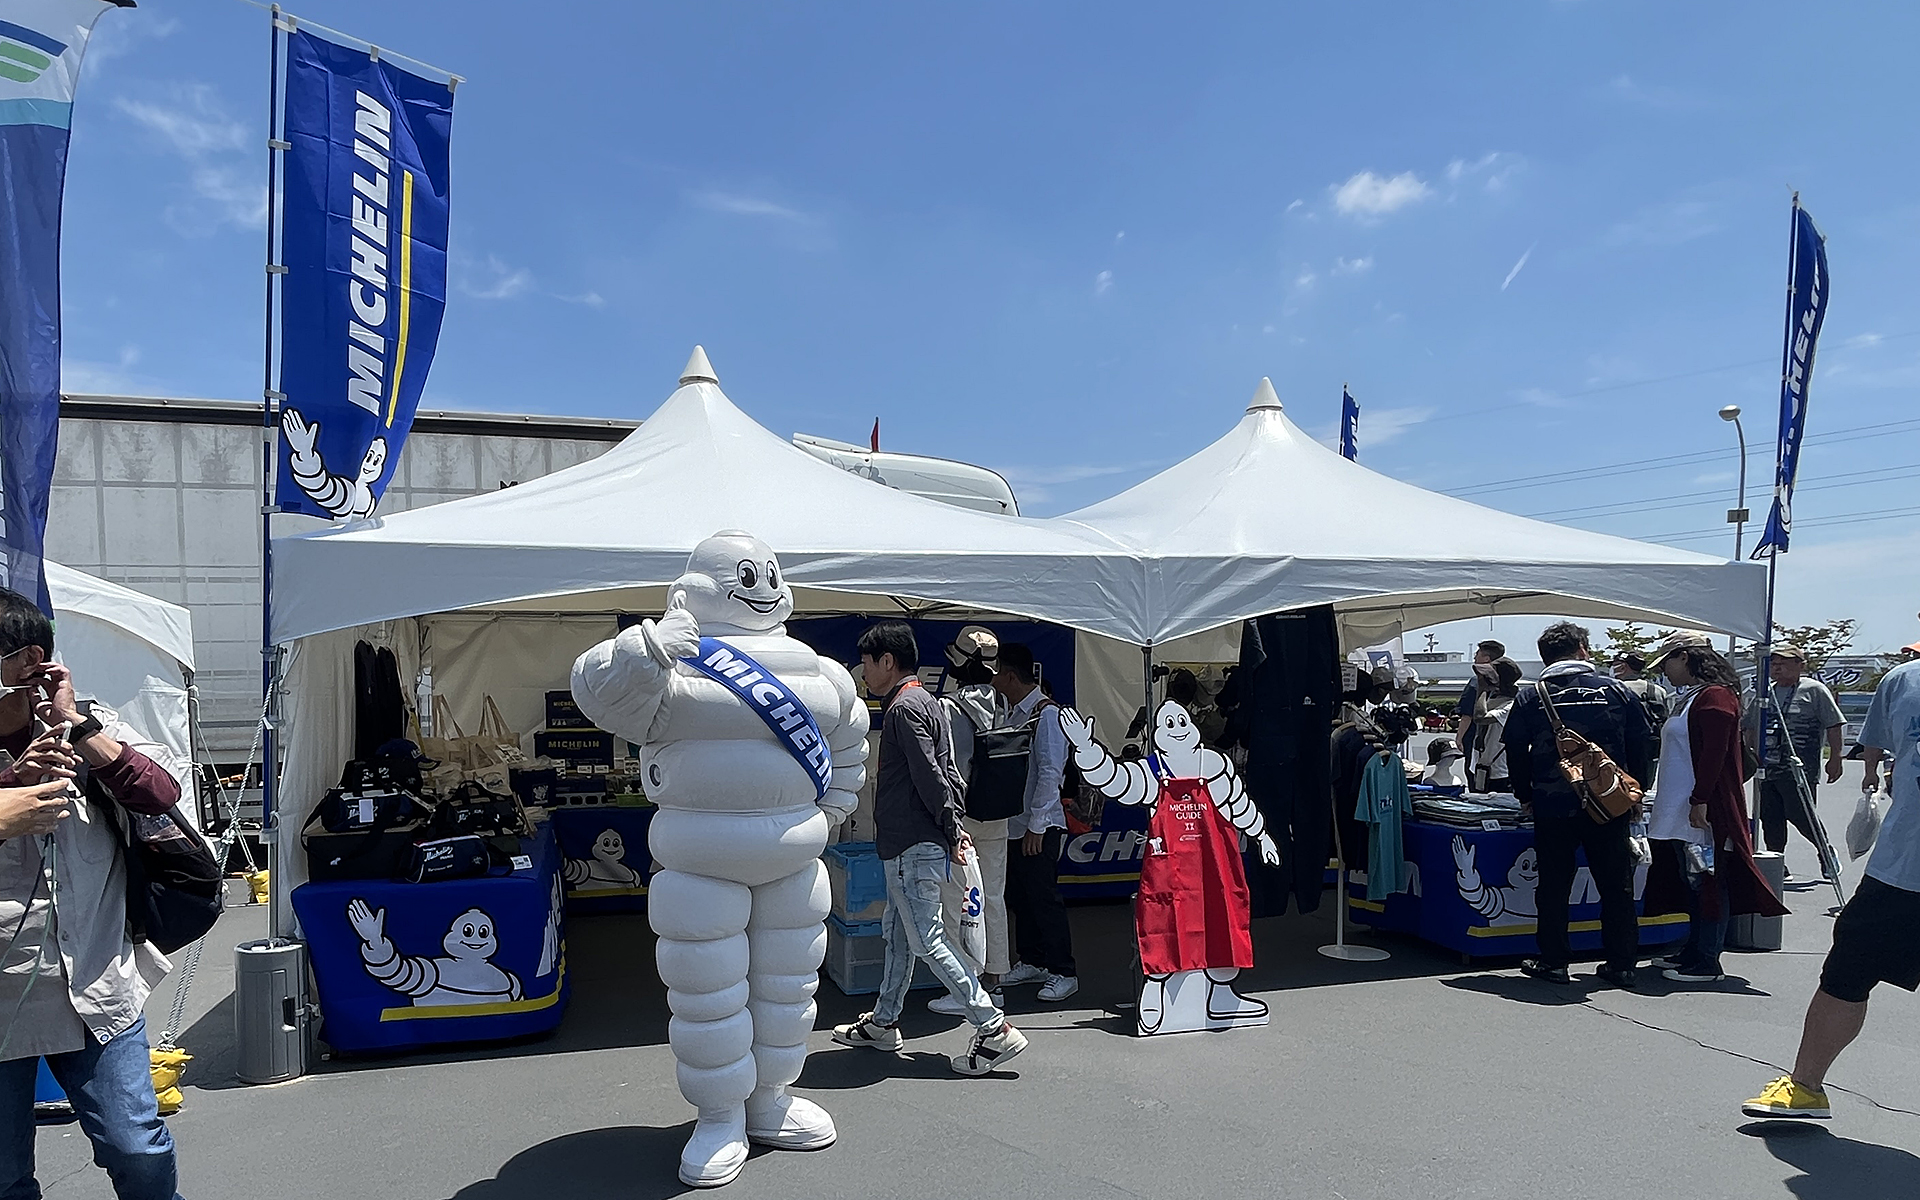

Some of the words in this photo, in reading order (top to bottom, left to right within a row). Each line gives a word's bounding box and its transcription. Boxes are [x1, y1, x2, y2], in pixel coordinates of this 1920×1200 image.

[348, 89, 391, 417] MICHELIN
[548, 740, 600, 748] MICHELIN
[1169, 803, 1208, 811] MICHELIN
[1175, 811, 1202, 820] GUIDE
